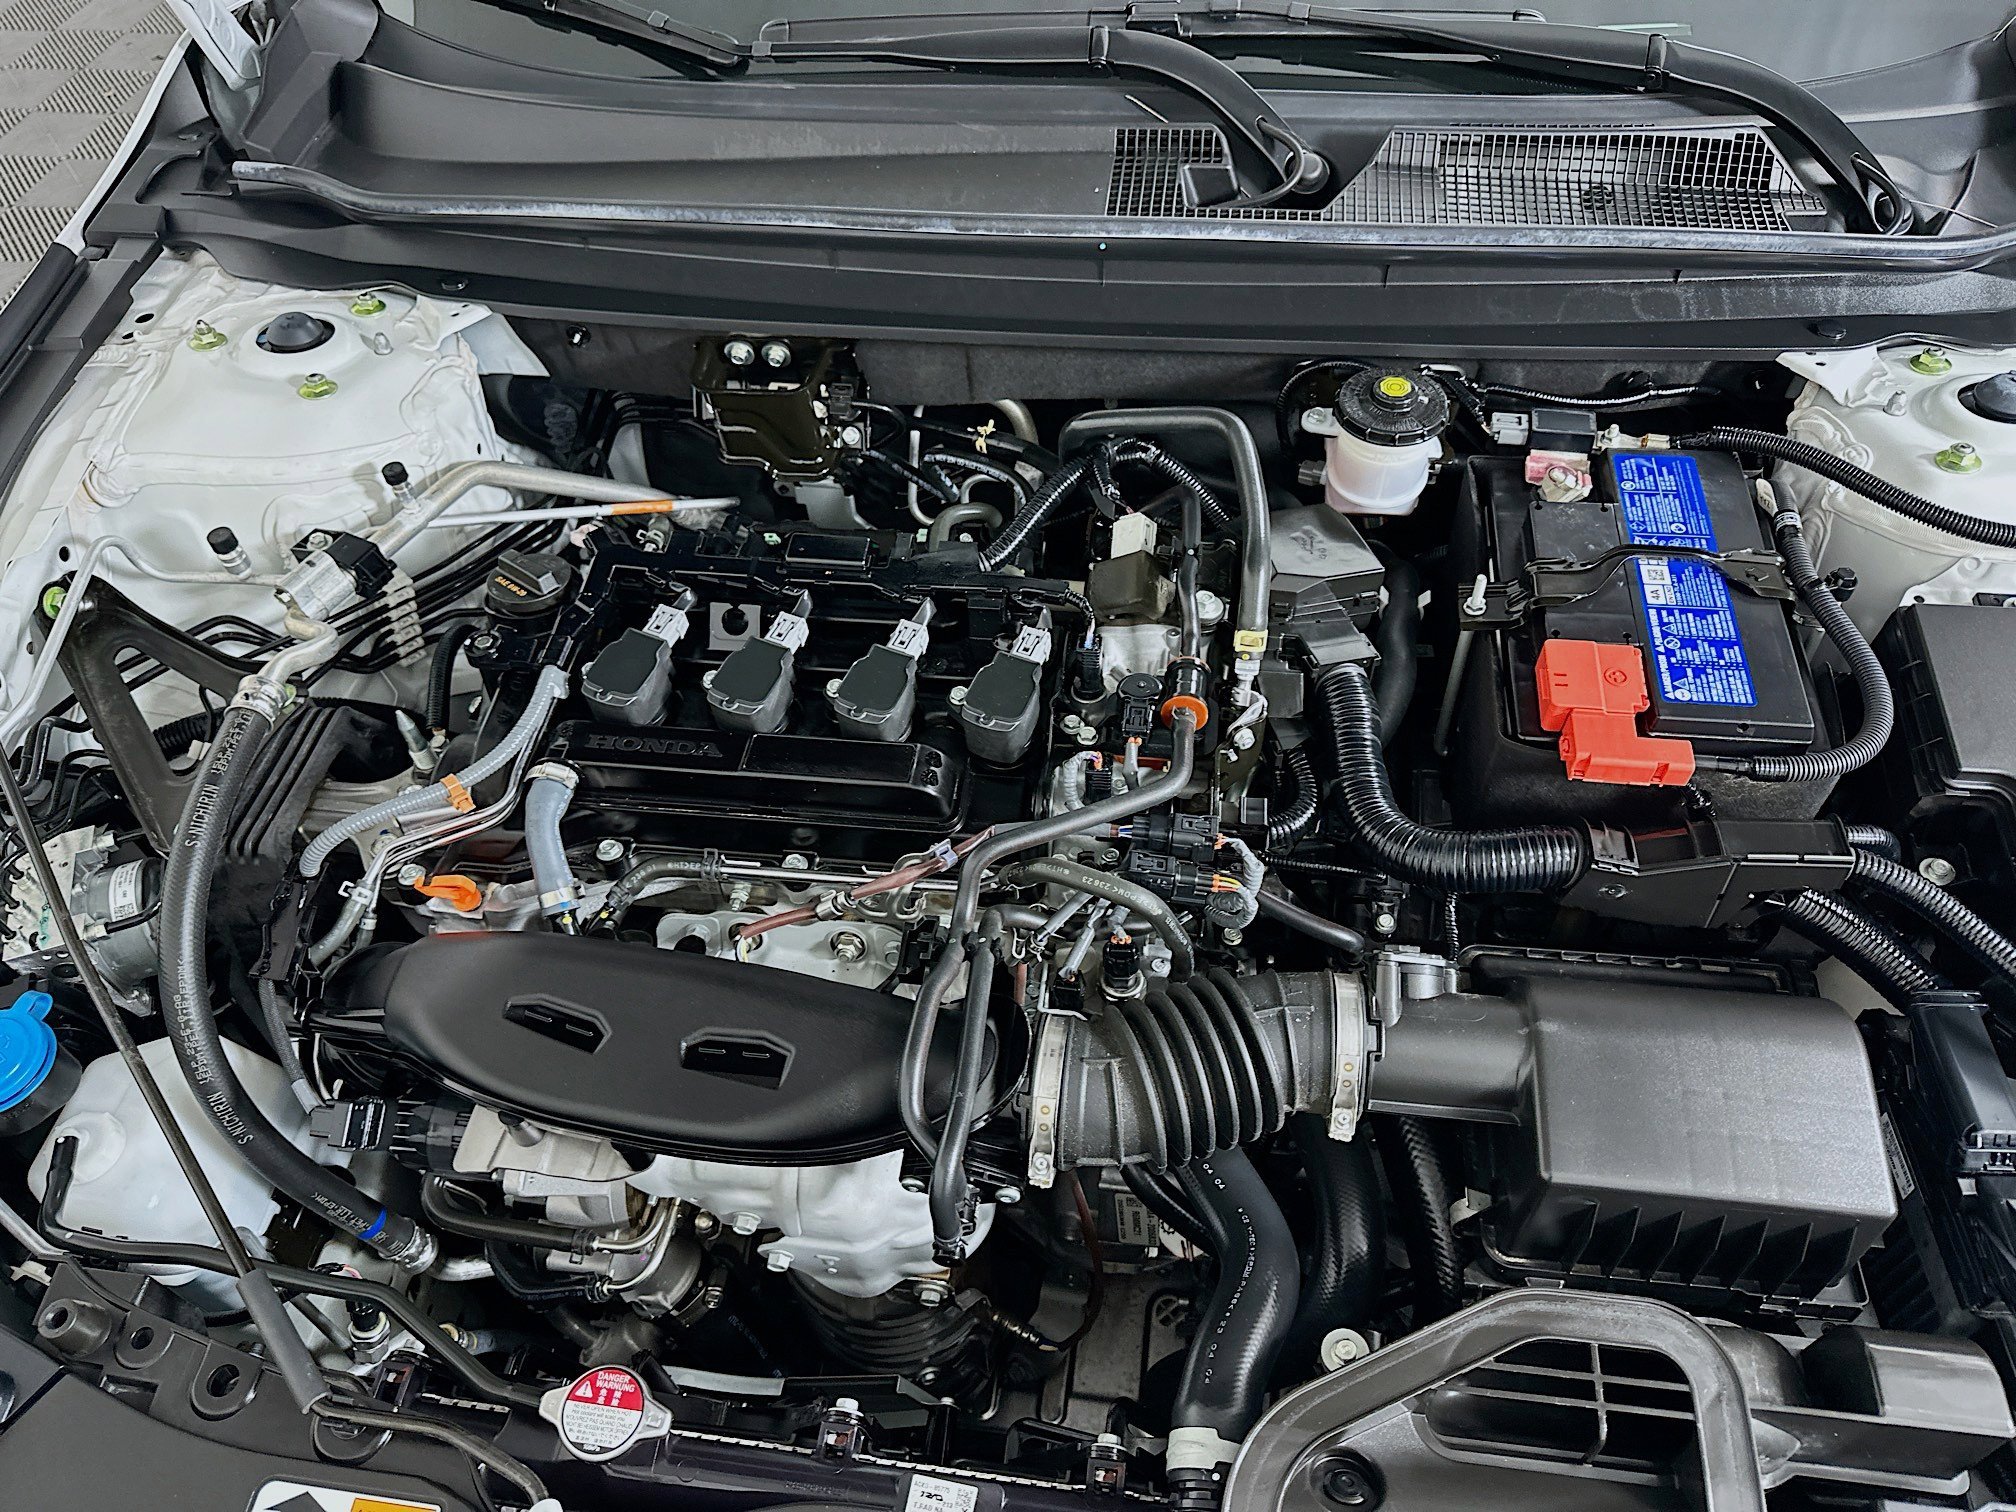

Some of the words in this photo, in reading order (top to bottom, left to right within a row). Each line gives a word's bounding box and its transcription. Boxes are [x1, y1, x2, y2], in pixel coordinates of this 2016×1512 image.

[584, 733, 723, 758] HONDA
[598, 1371, 631, 1383] DANGER
[596, 1380, 636, 1393] WARNUNG
